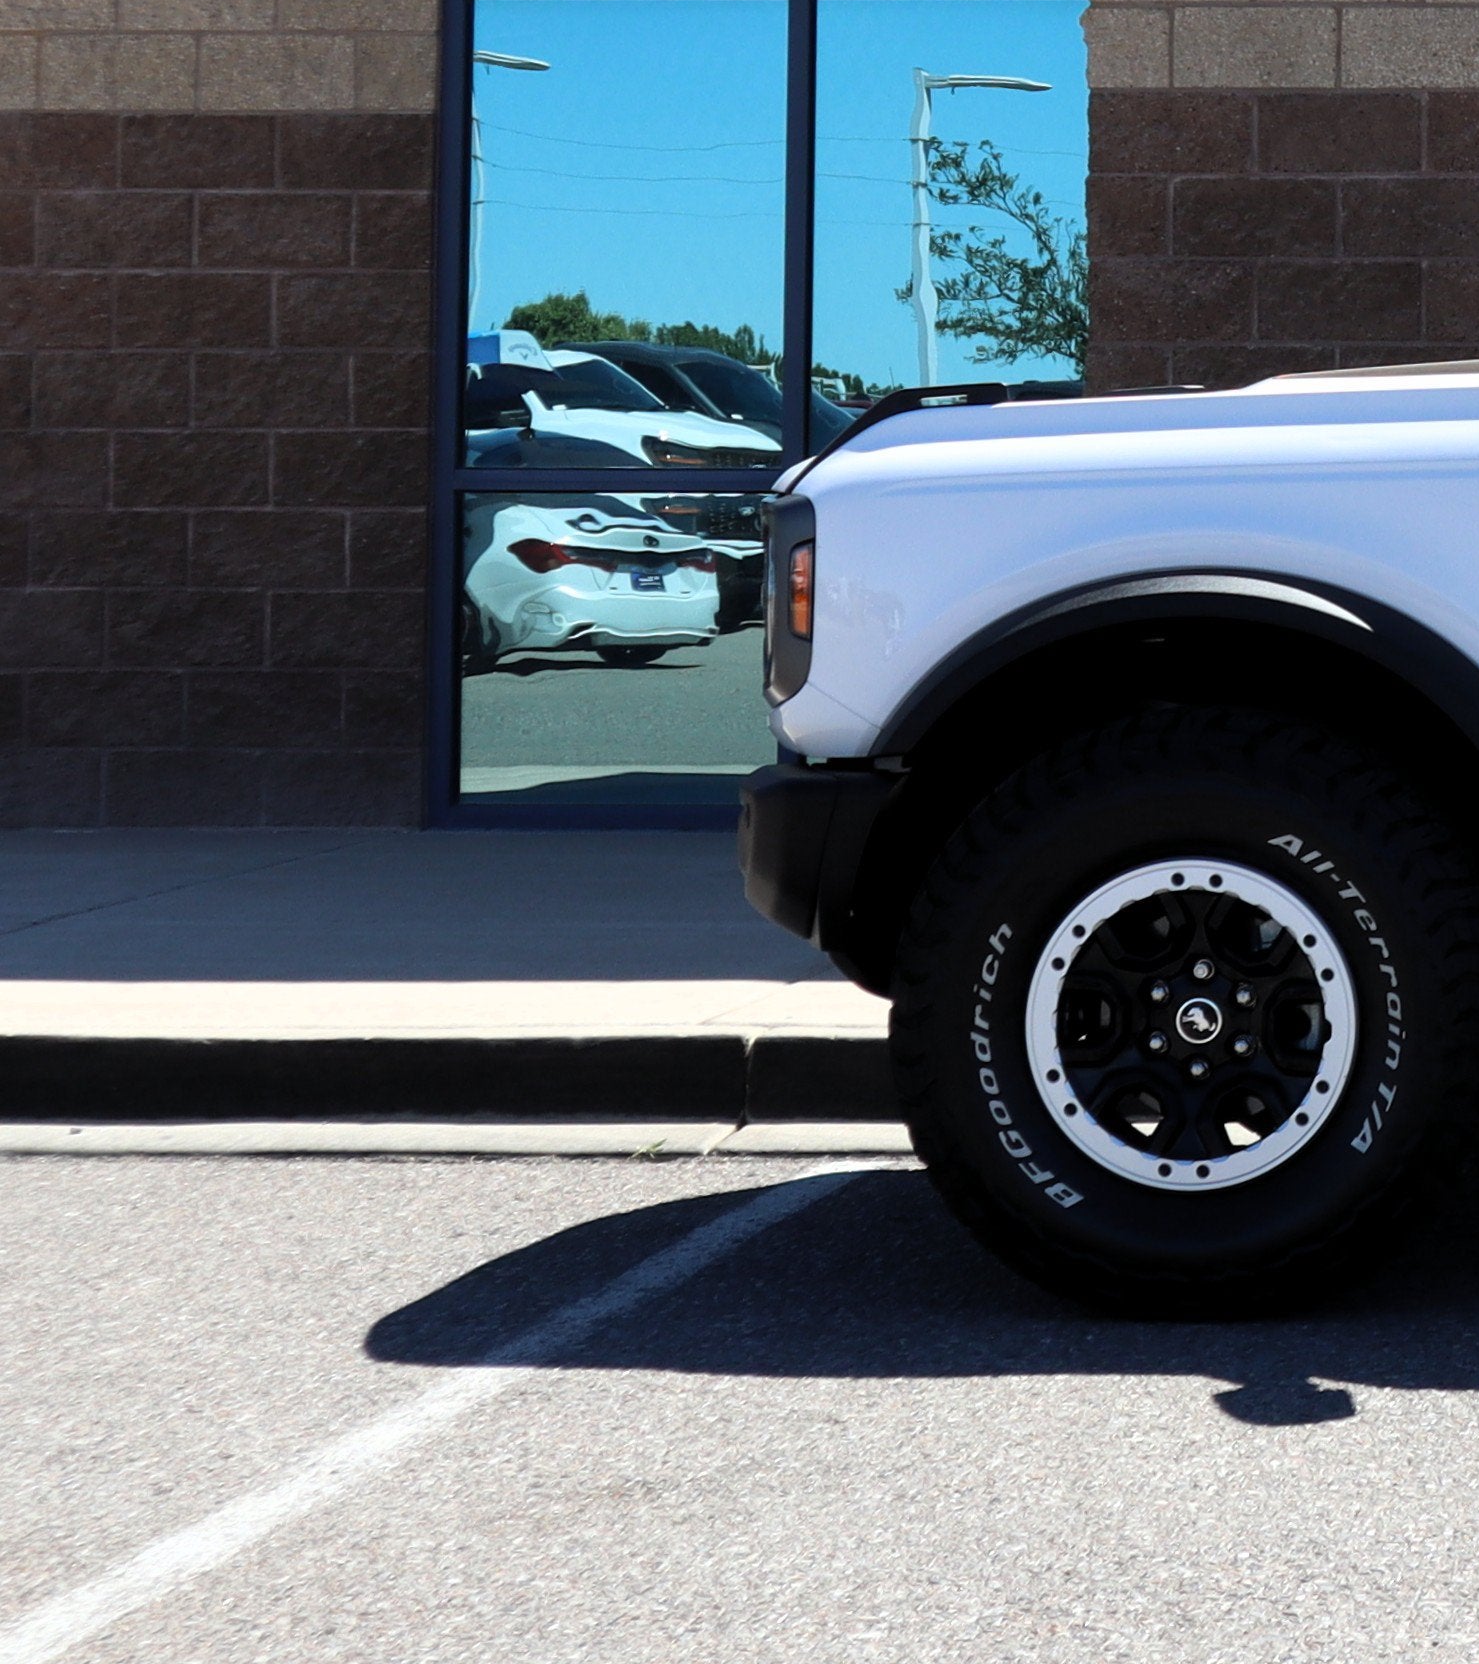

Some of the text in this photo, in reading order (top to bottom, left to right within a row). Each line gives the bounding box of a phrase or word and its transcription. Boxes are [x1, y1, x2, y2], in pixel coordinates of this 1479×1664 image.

[970, 923, 1084, 1208] BFGoodrich
[1268, 834, 1405, 1153] All-Terrain T/A
